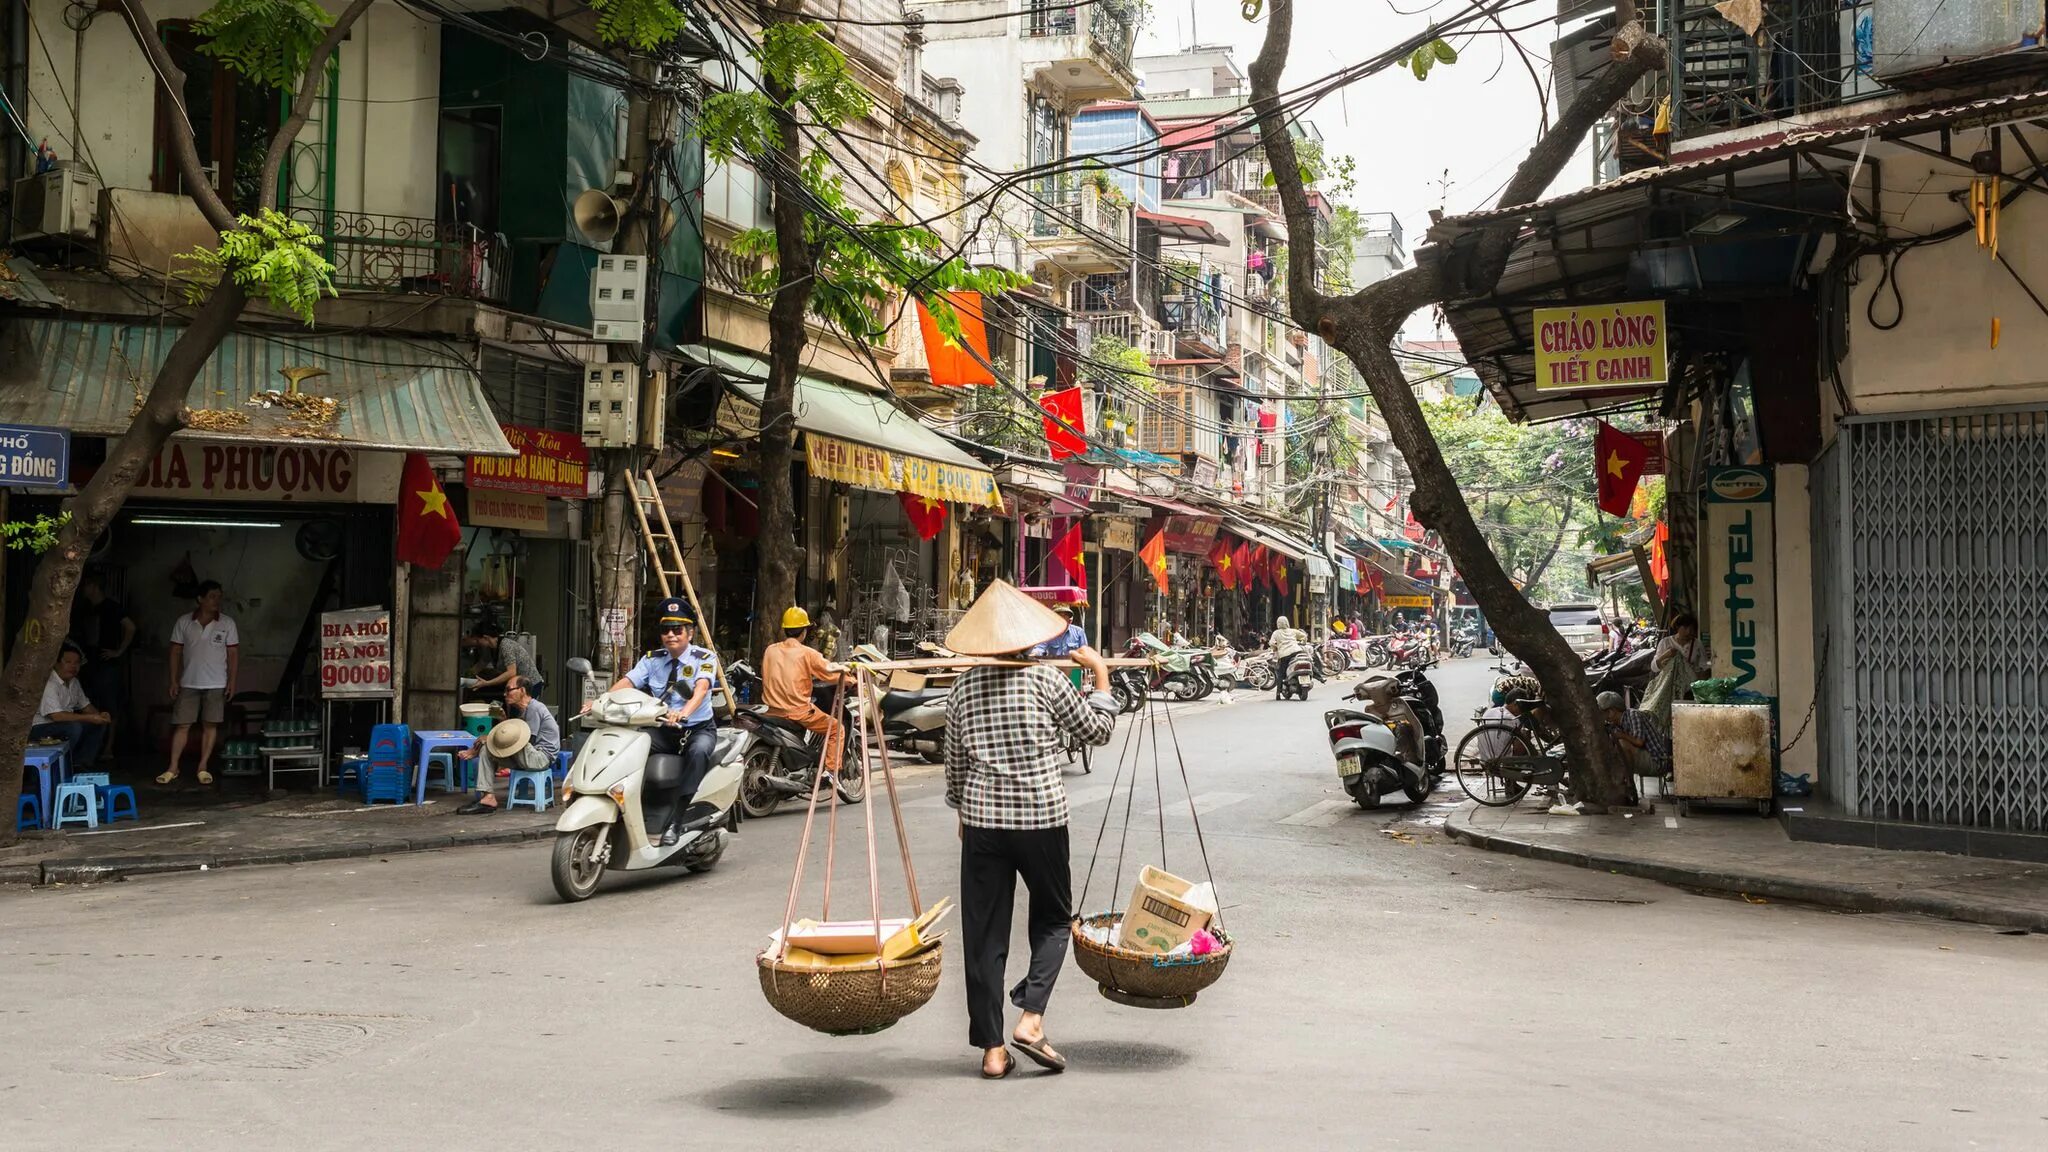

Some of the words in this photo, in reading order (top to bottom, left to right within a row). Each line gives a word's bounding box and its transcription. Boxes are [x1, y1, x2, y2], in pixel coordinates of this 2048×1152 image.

[1541, 312, 1597, 353] CHÁO
[1601, 308, 1657, 348] LÒNG
[1549, 353, 1590, 384] TIẾT
[1596, 356, 1652, 381] CANH
[0, 433, 30, 449] HỐ
[11, 450, 57, 478] ĐỒNG
[529, 451, 556, 482] HÀNG
[1031, 591, 1058, 600] SOUCI
[24, 617, 41, 644] 10
[322, 622, 355, 638] BIA
[323, 642, 350, 661] HÀ
[353, 641, 385, 663] NỘI
[322, 664, 375, 688] 9000
